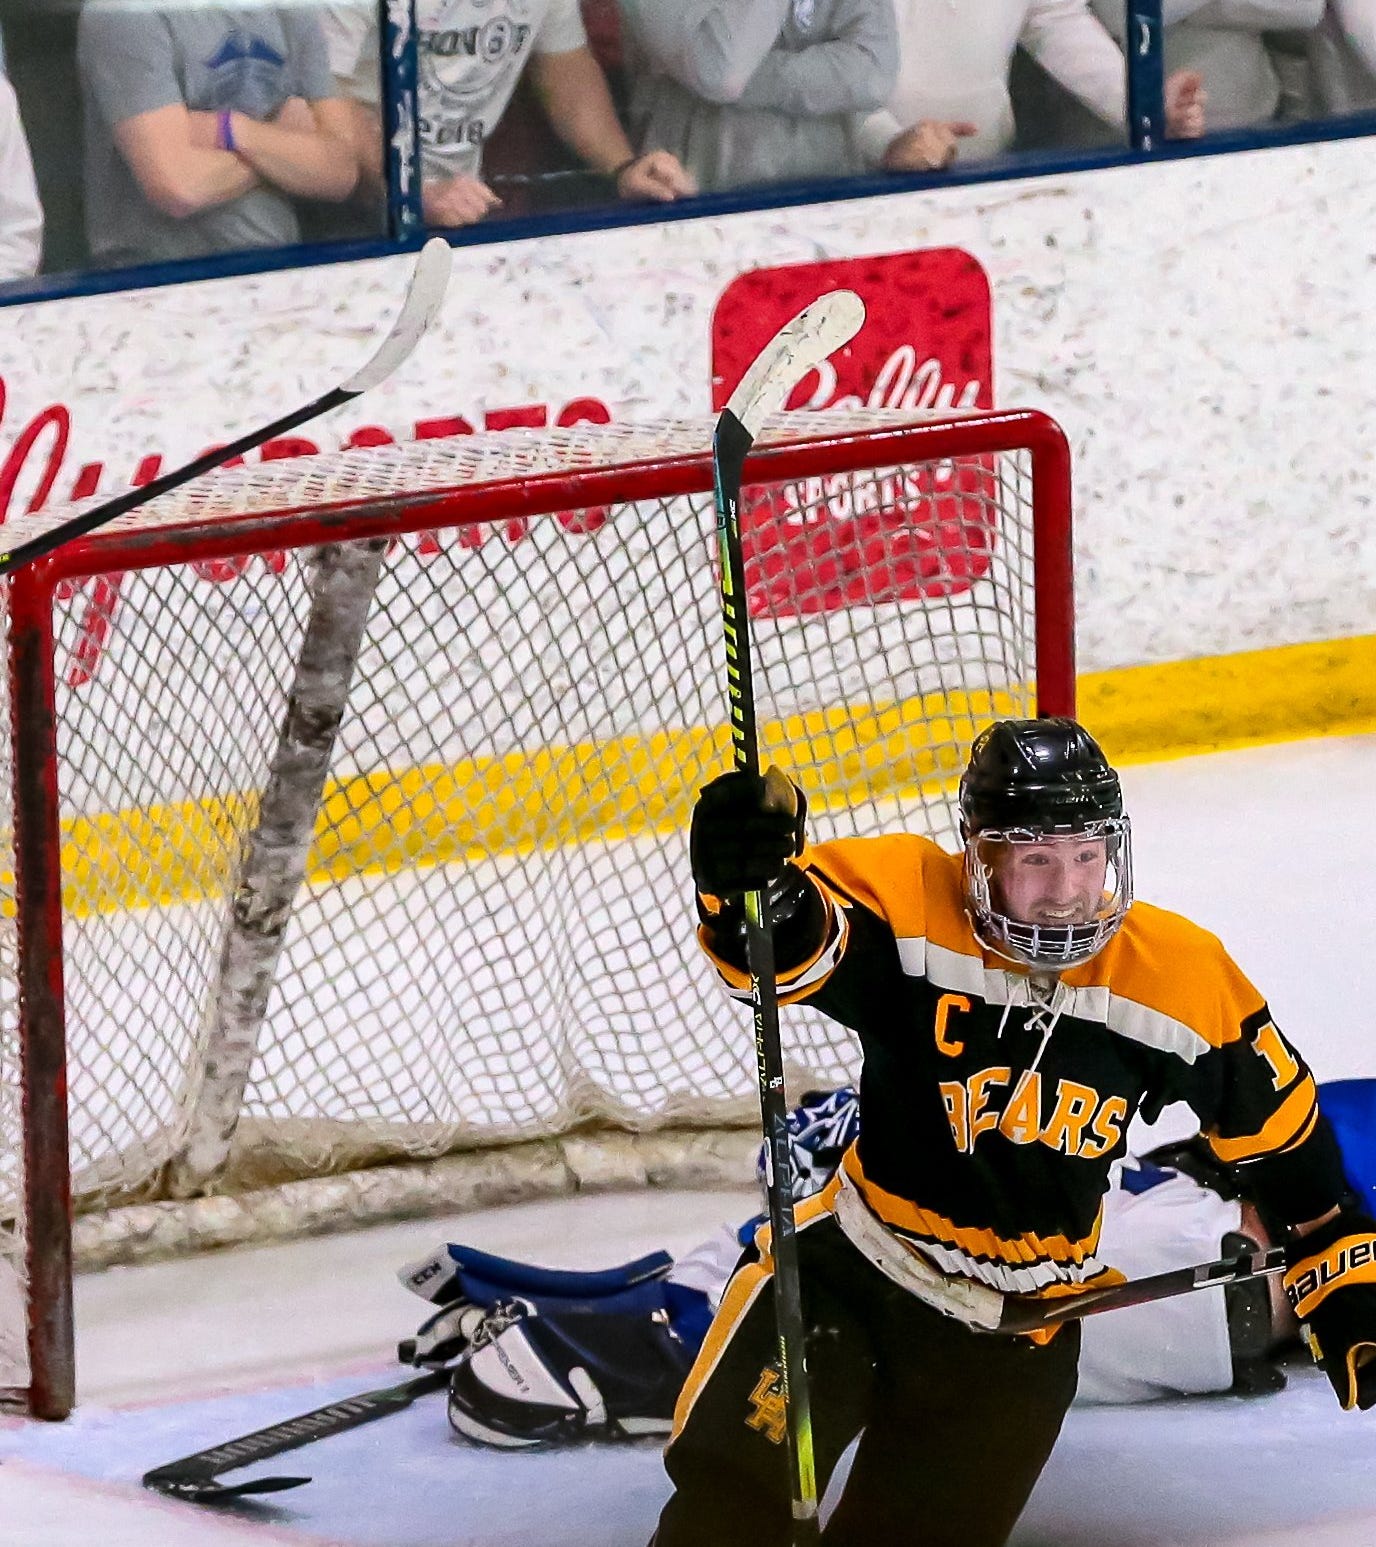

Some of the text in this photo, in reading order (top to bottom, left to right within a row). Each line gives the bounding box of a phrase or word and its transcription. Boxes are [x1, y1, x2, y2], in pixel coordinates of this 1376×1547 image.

[934, 993, 971, 1058] C
[938, 1066, 1129, 1160] BEARS
[773, 1112, 794, 1237] ALPHA
